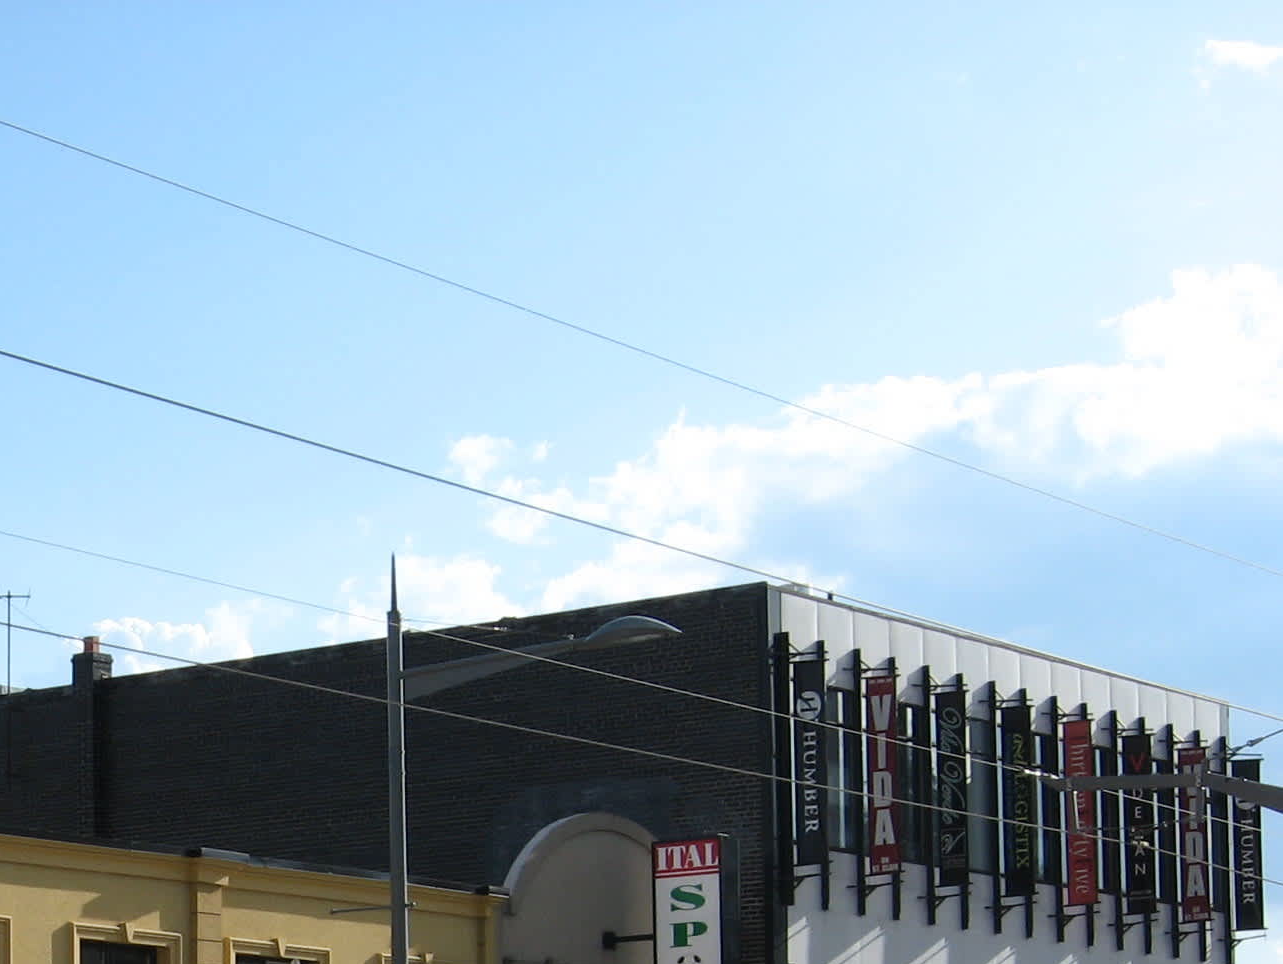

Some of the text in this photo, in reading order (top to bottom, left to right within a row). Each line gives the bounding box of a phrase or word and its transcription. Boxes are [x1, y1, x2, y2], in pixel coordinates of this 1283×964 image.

[802, 731, 819, 832] HUMBER
[870, 694, 896, 845] VIDA
[656, 842, 718, 870] ITAL
[1239, 819, 1257, 904] HUMBER
